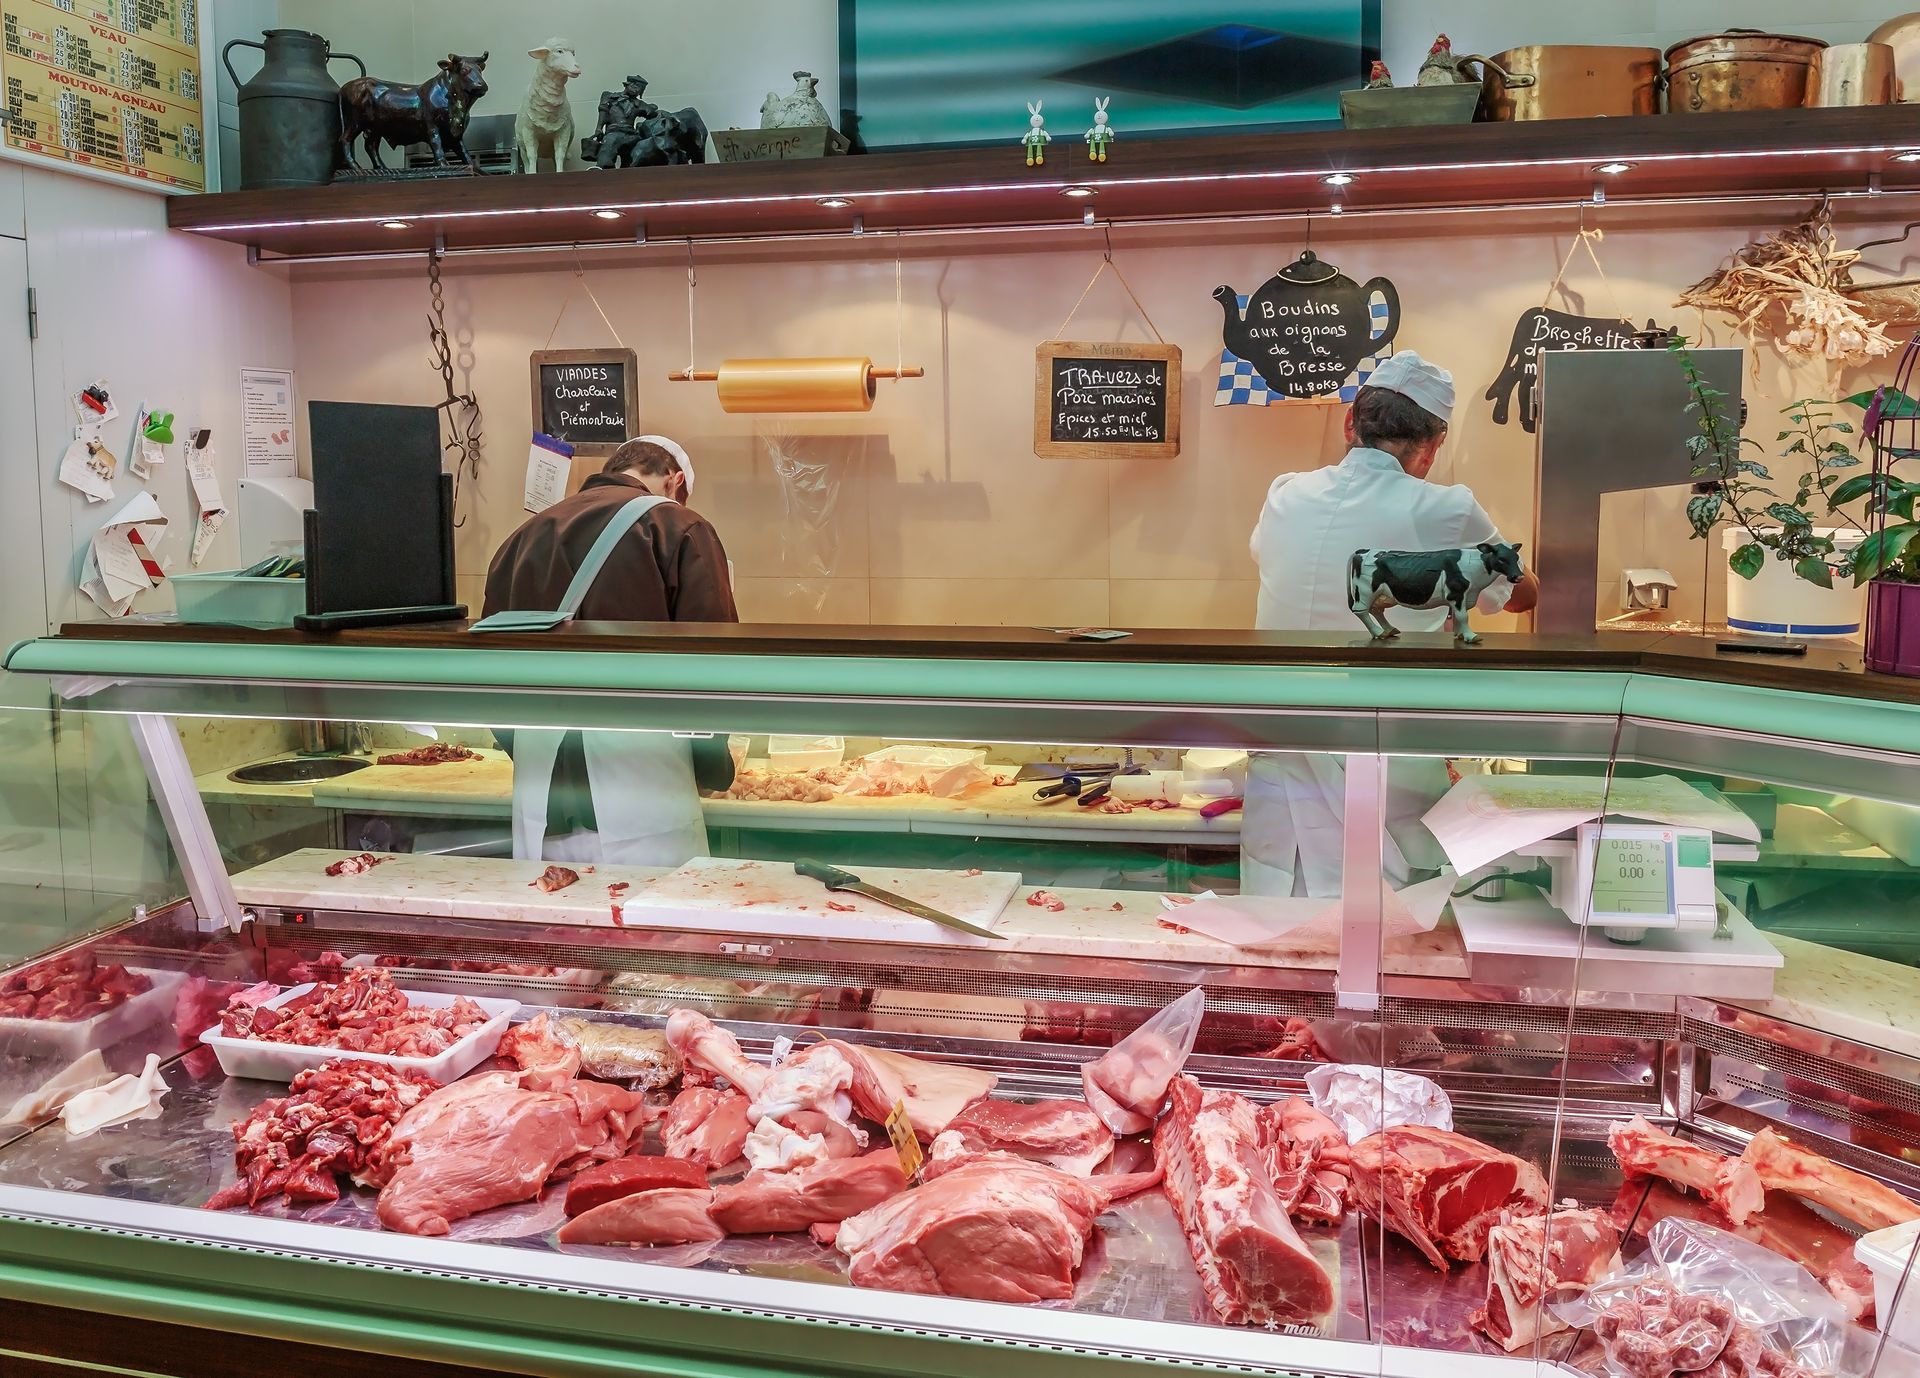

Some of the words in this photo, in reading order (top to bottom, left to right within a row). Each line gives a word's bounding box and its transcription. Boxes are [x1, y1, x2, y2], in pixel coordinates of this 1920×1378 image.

[90, 25, 127, 45] VEAU
[48, 71, 166, 114] MOUTON-AGNEAU
[723, 136, 801, 162] Auvergne
[1261, 300, 1340, 319] Boudins
[1250, 327, 1279, 339] aux
[1286, 324, 1347, 343] oignons
[1269, 344, 1290, 355] de
[1310, 342, 1330, 355] la
[556, 368, 608, 382] VIANDES
[1146, 368, 1162, 386] de
[1057, 388, 1097, 405] Porc
[580, 401, 591, 412] et
[1059, 413, 1096, 430] Epices
[1102, 413, 1115, 424] et
[1119, 412, 1147, 425] miel
[1145, 426, 1159, 440] Kg
[1611, 840, 1642, 850] 0.015
[1619, 853, 1643, 863] 0.00
[1619, 867, 1644, 878] 0.00
